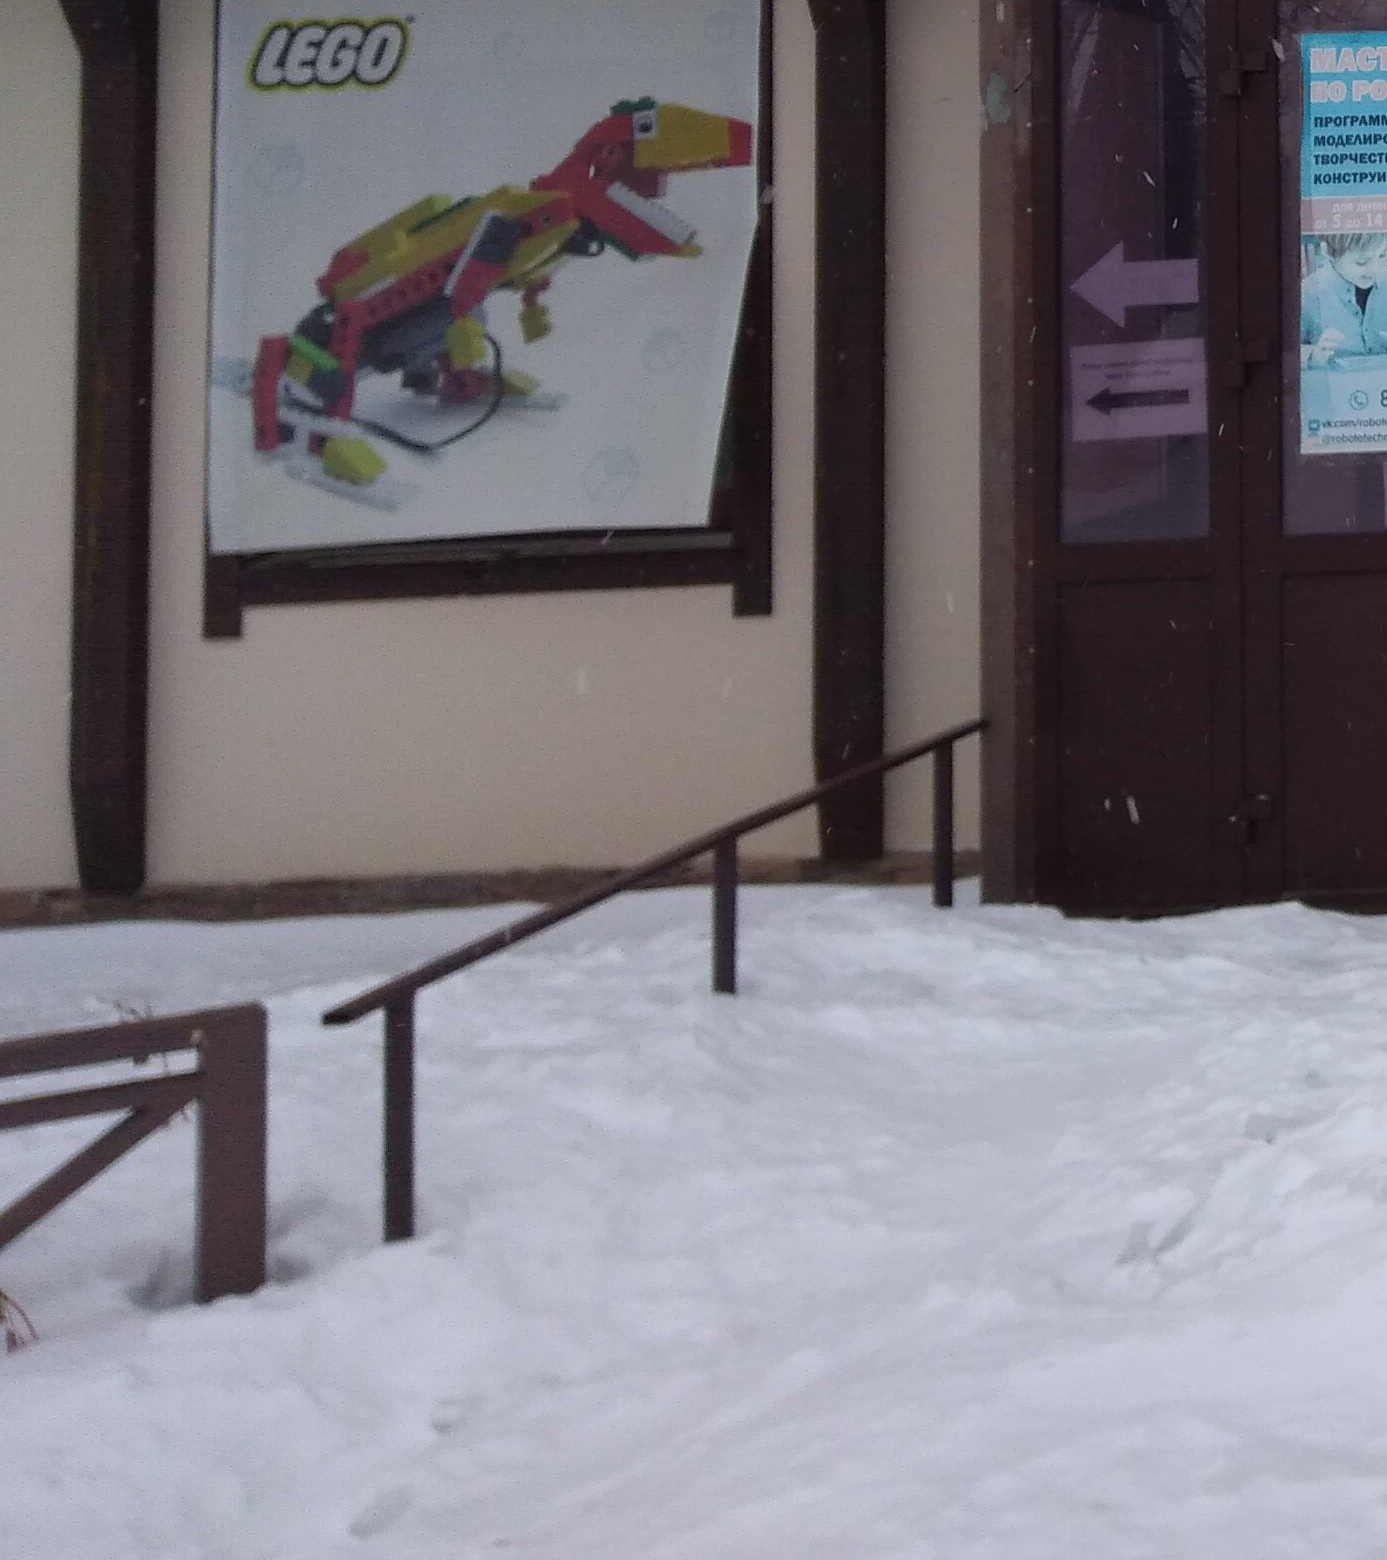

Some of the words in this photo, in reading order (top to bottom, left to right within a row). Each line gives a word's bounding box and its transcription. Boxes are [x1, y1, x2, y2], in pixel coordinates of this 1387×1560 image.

[249, 16, 412, 92] LEGO
[1310, 80, 1347, 103] ПО
[1332, 214, 1342, 229] 5
[1366, 213, 1383, 228] 14
